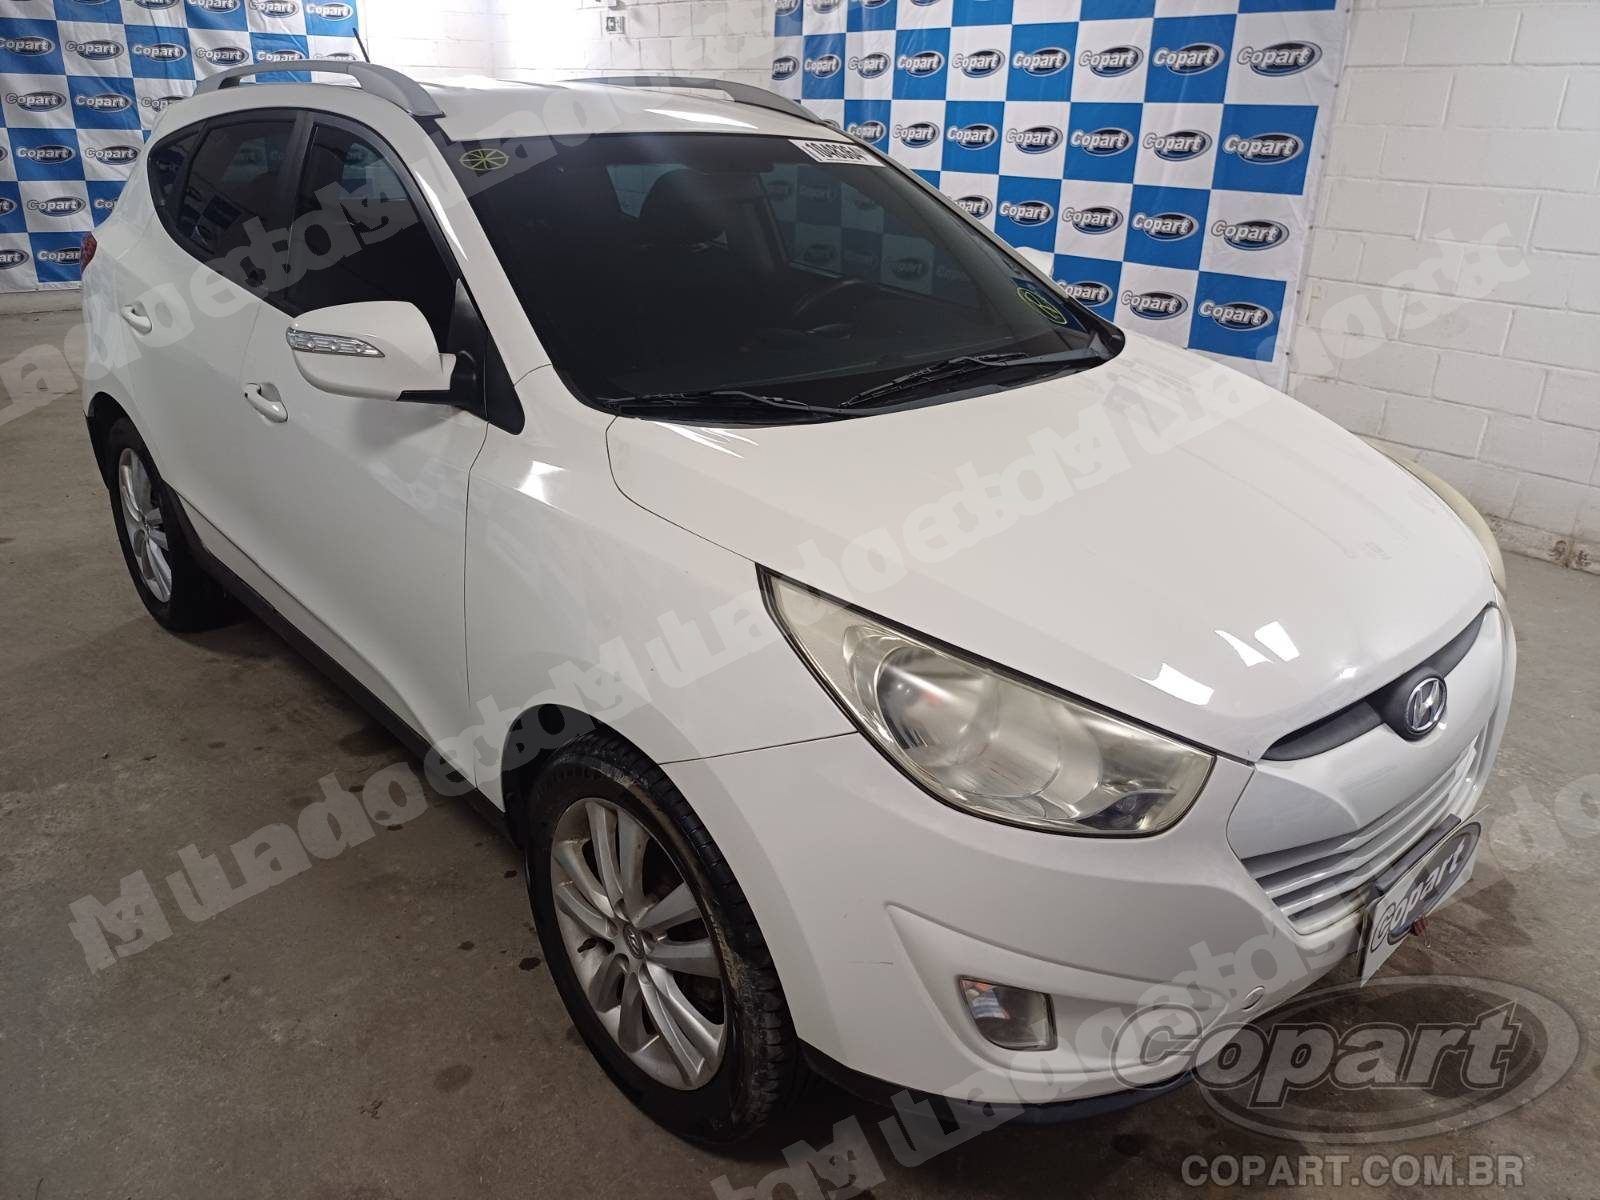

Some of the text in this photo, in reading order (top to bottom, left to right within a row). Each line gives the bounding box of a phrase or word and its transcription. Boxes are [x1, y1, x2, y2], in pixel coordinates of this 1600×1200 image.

[306, 4, 348, 17] Copart
[65, 41, 117, 55] Copart
[133, 44, 180, 58] Copart
[196, 48, 243, 62] Copart
[256, 51, 300, 61] Copart
[804, 57, 837, 74] Copart
[849, 56, 883, 72] Copart
[897, 55, 939, 73] Copart
[952, 53, 998, 70] Copart
[1013, 51, 1062, 70] Copart
[1079, 50, 1134, 70] Copart
[1154, 48, 1217, 69] Copart
[1237, 46, 1309, 69] Copart
[6, 92, 57, 107] Copart
[76, 95, 125, 109] Copart
[847, 123, 881, 141] Copart
[893, 124, 933, 142] Copart
[947, 125, 992, 143] Copart
[1006, 128, 1055, 148] Copart
[1070, 130, 1125, 149] Copart
[1143, 133, 1201, 153] Copart
[1223, 135, 1295, 156] Copart
[16, 147, 69, 160] Copart
[86, 148, 134, 161] Copart
[27, 199, 77, 212] Copart
[1000, 201, 1047, 219] Copart
[1062, 207, 1115, 227] Copart
[1132, 214, 1193, 235] Copart
[1211, 220, 1278, 242] Copart
[1121, 290, 1179, 313] Copart
[1199, 301, 1264, 325] Copart
[1370, 839, 1465, 953] Copart
